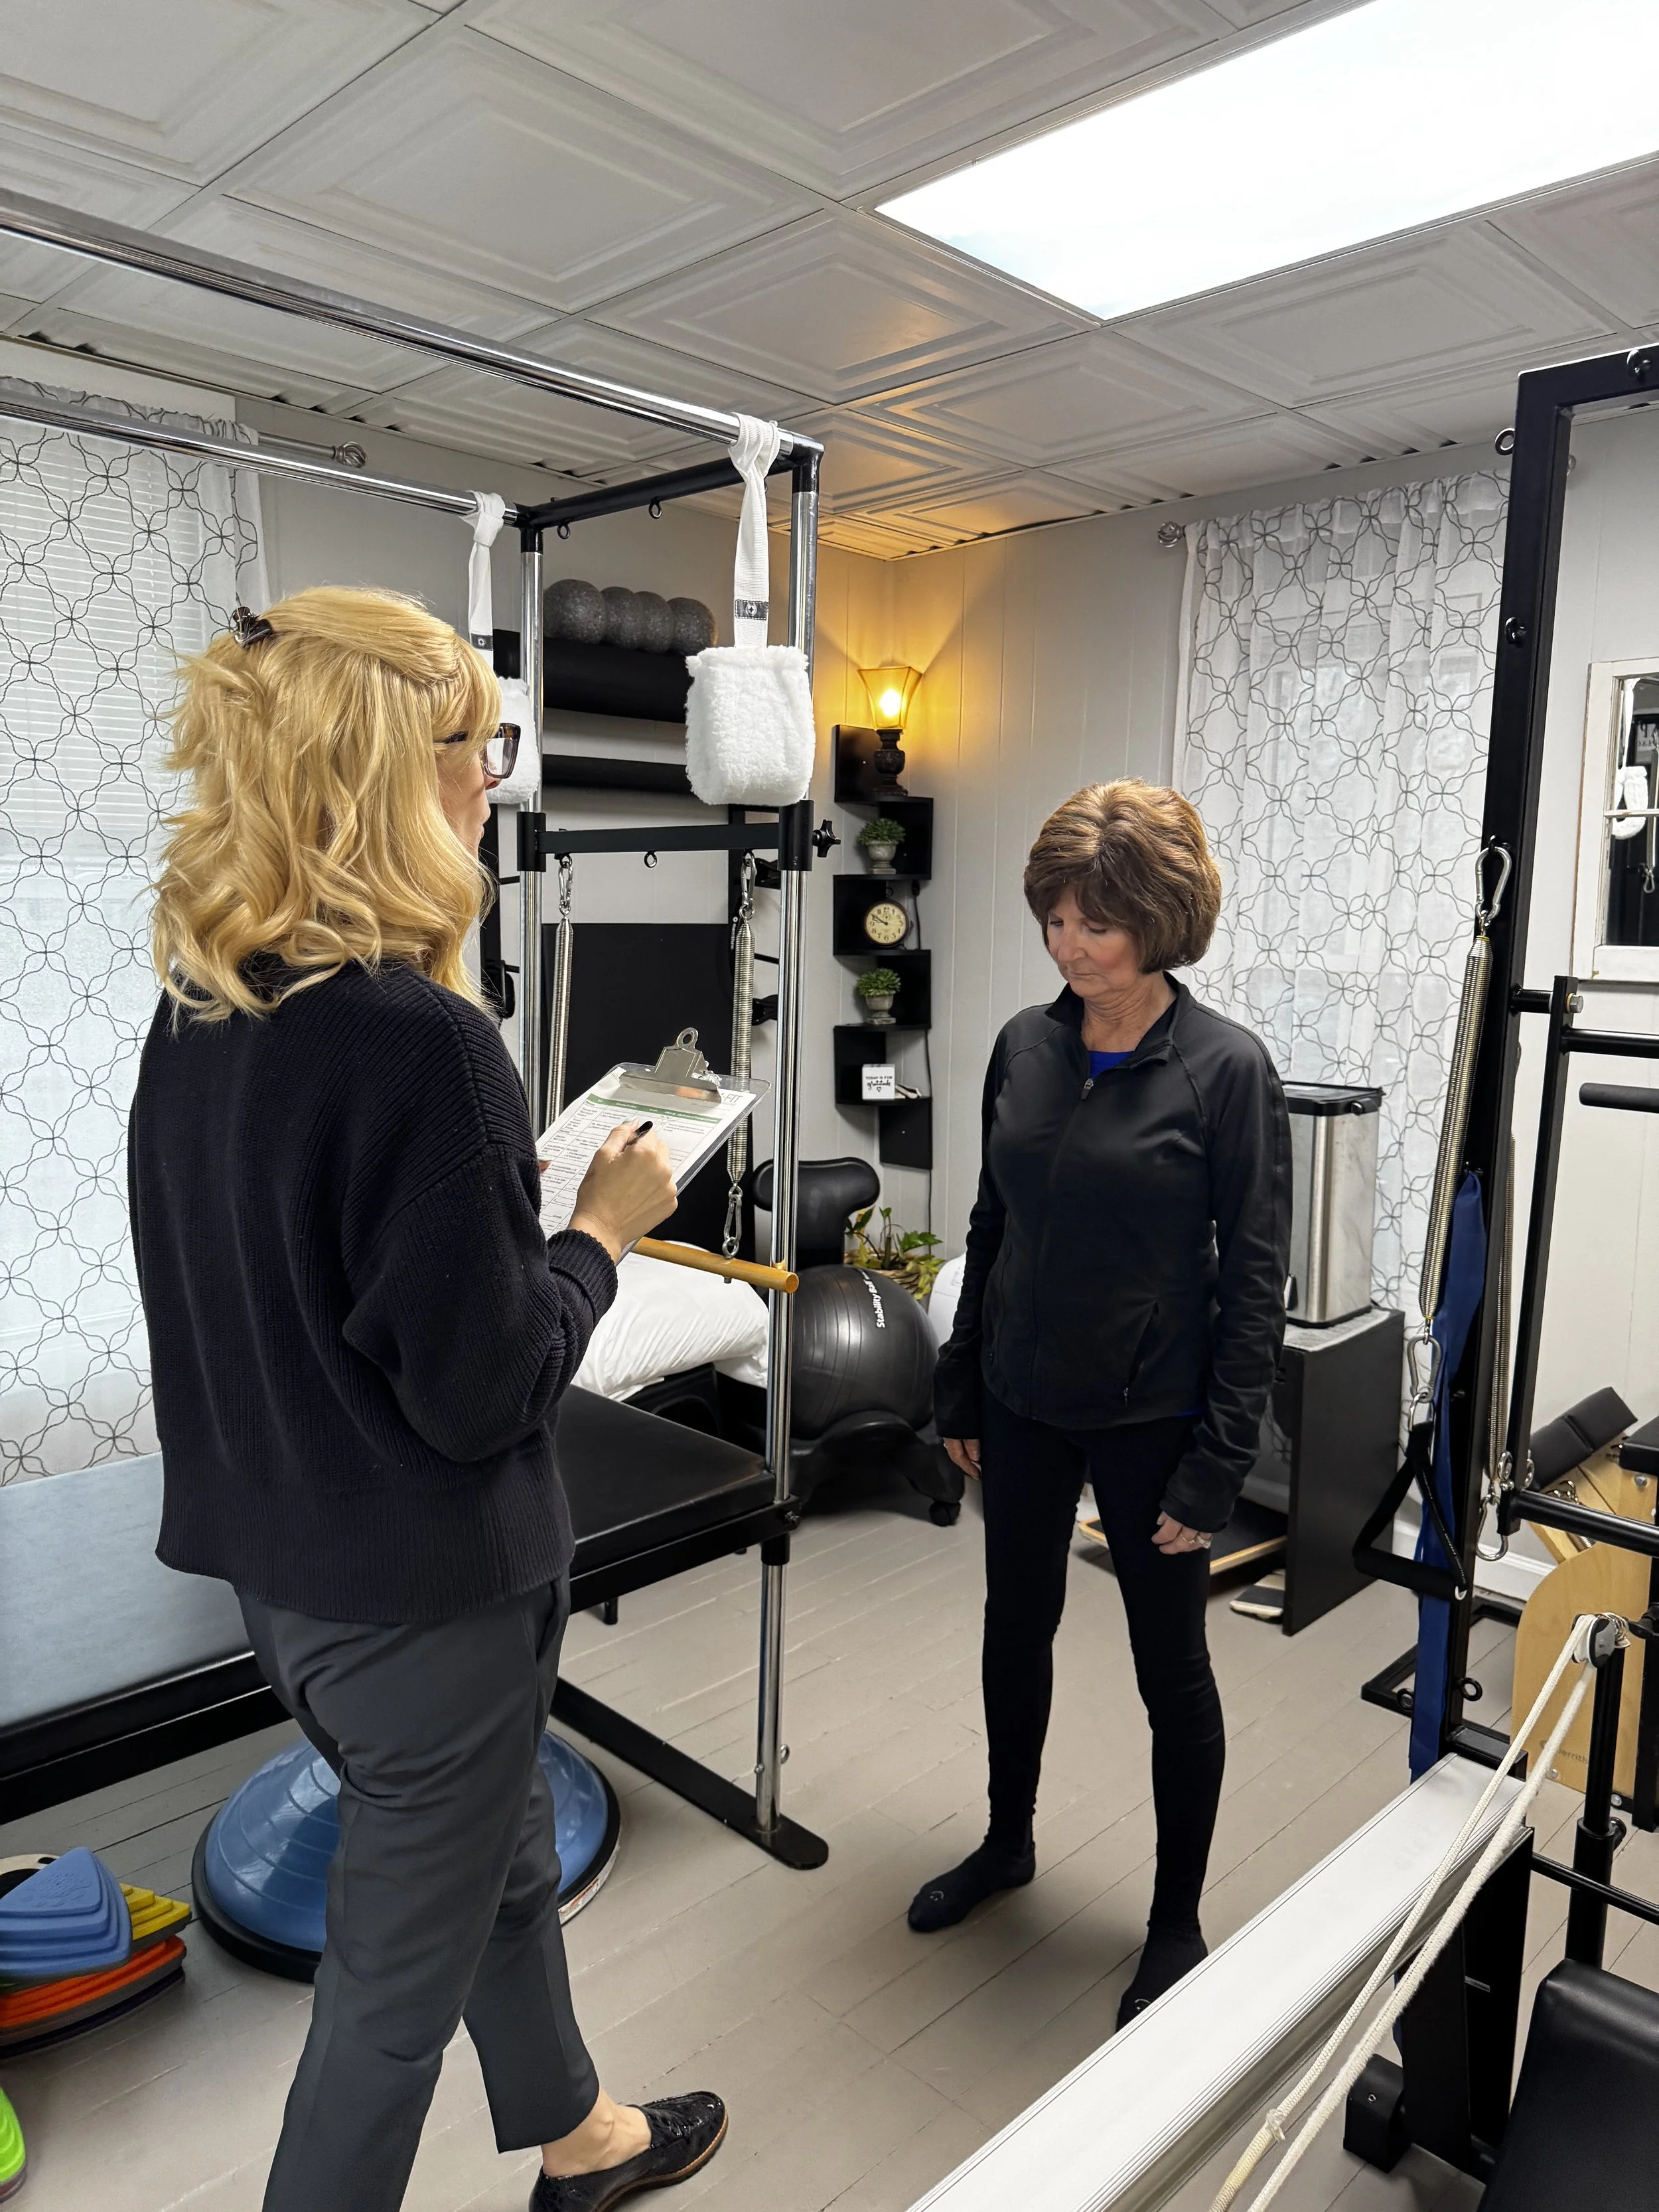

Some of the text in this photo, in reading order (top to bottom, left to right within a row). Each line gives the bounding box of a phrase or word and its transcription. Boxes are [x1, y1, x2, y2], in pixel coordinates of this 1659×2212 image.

[867, 1080, 891, 1090] gratitude
[863, 1279, 877, 1293] Ball
[872, 1293, 886, 1328] Stability
